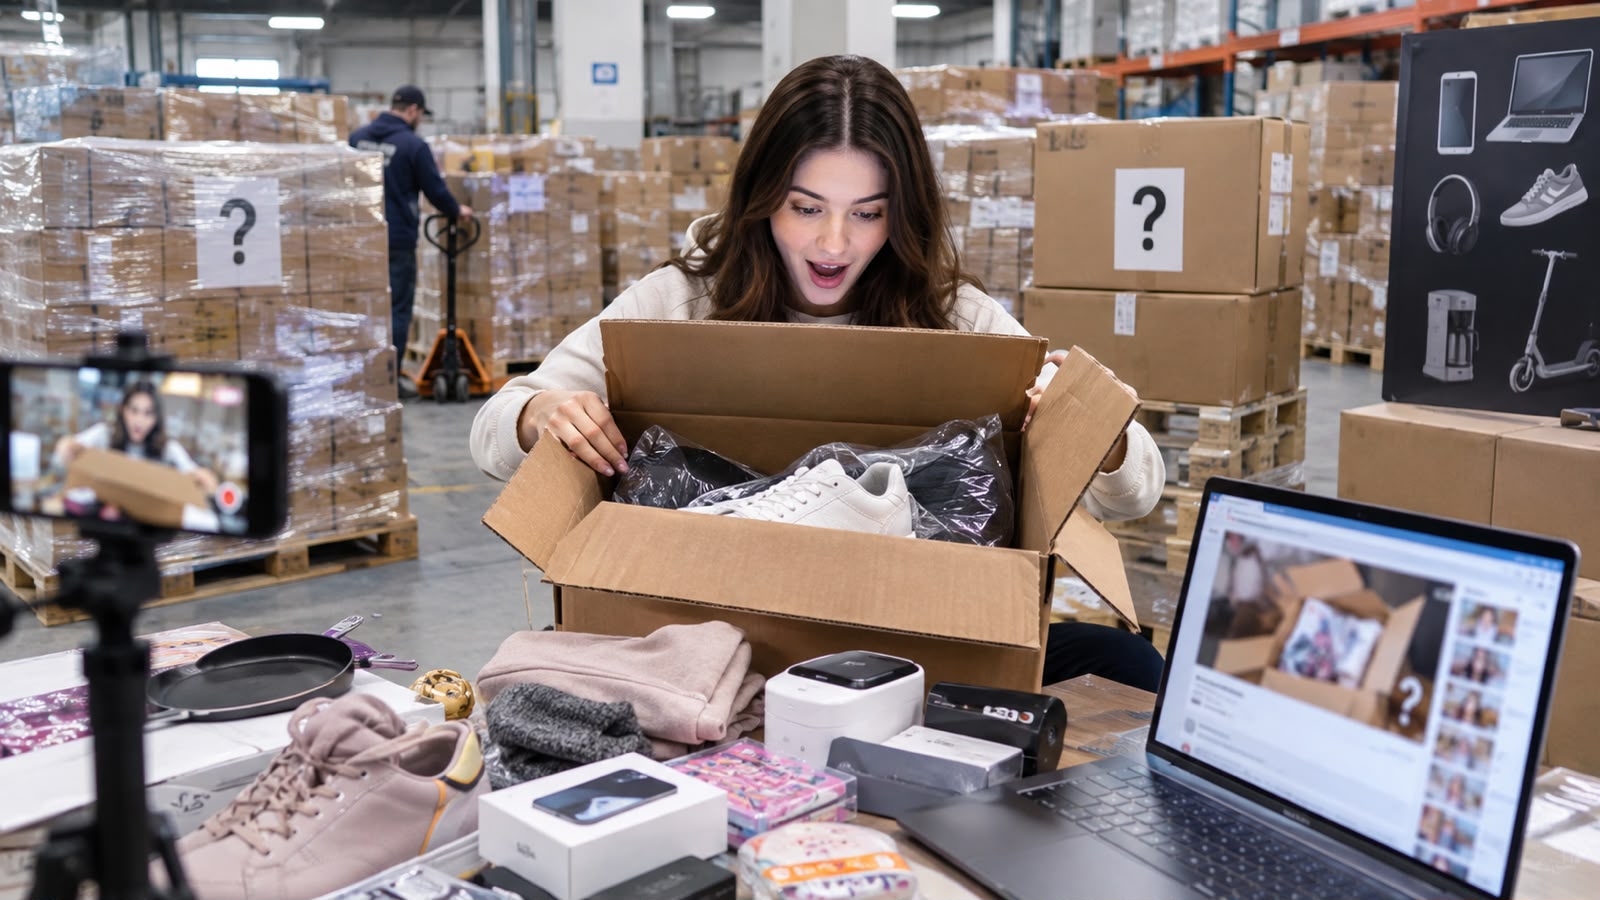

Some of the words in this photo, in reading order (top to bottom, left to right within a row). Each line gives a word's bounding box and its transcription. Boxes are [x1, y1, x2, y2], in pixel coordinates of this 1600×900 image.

[220, 198, 256, 266] ?
[1132, 185, 1166, 252] ?
[1399, 677, 1422, 725] ?
